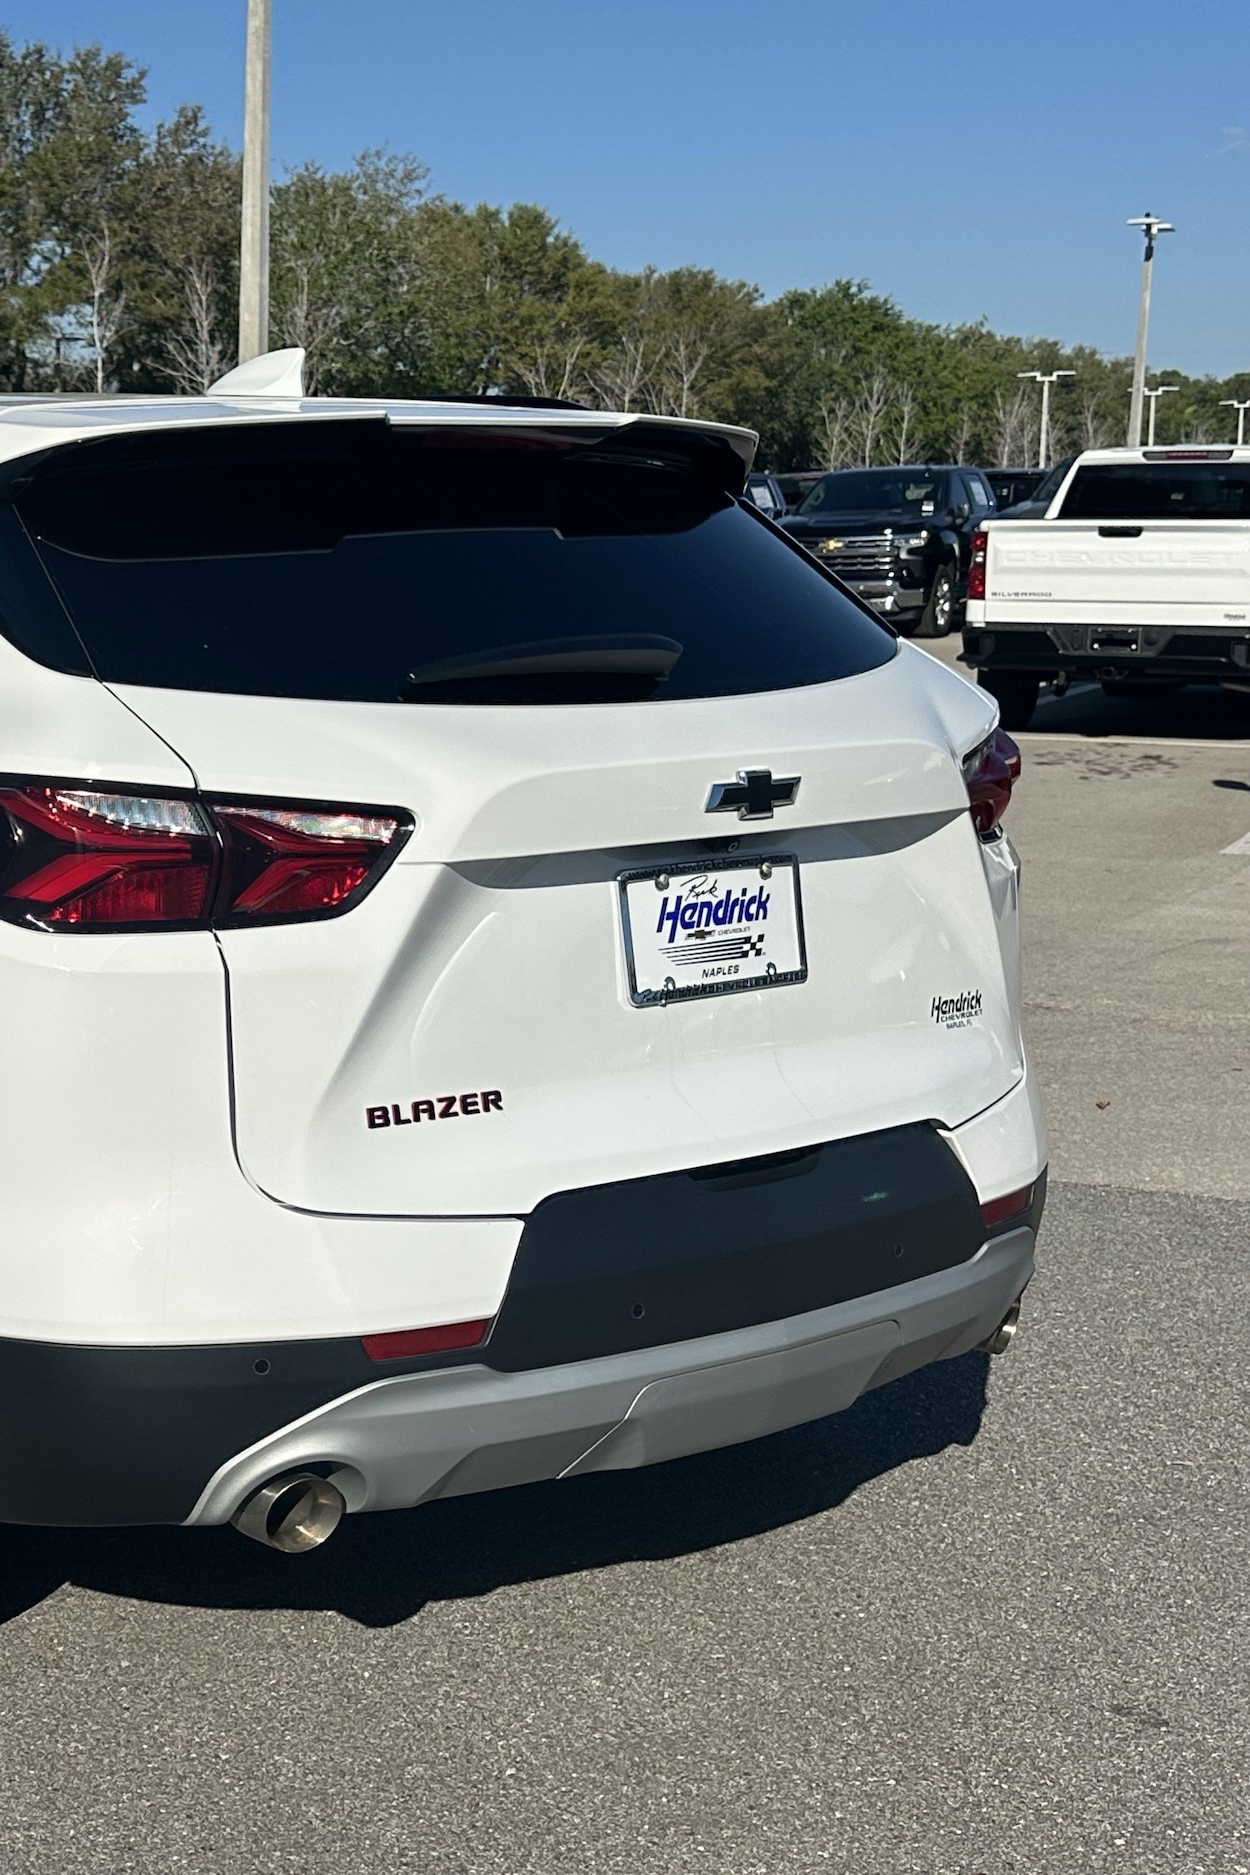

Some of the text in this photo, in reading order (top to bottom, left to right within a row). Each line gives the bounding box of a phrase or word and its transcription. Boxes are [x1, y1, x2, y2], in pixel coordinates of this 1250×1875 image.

[1003, 550, 1240, 567] CHEVROLET
[656, 885, 770, 944] Hendrick
[717, 926, 751, 936] CHEVROLET
[701, 965, 740, 979] NAPLES
[931, 989, 982, 1024] Hendrick
[940, 1008, 982, 1022] CHEVROLET
[366, 1089, 504, 1130] BLAZER
